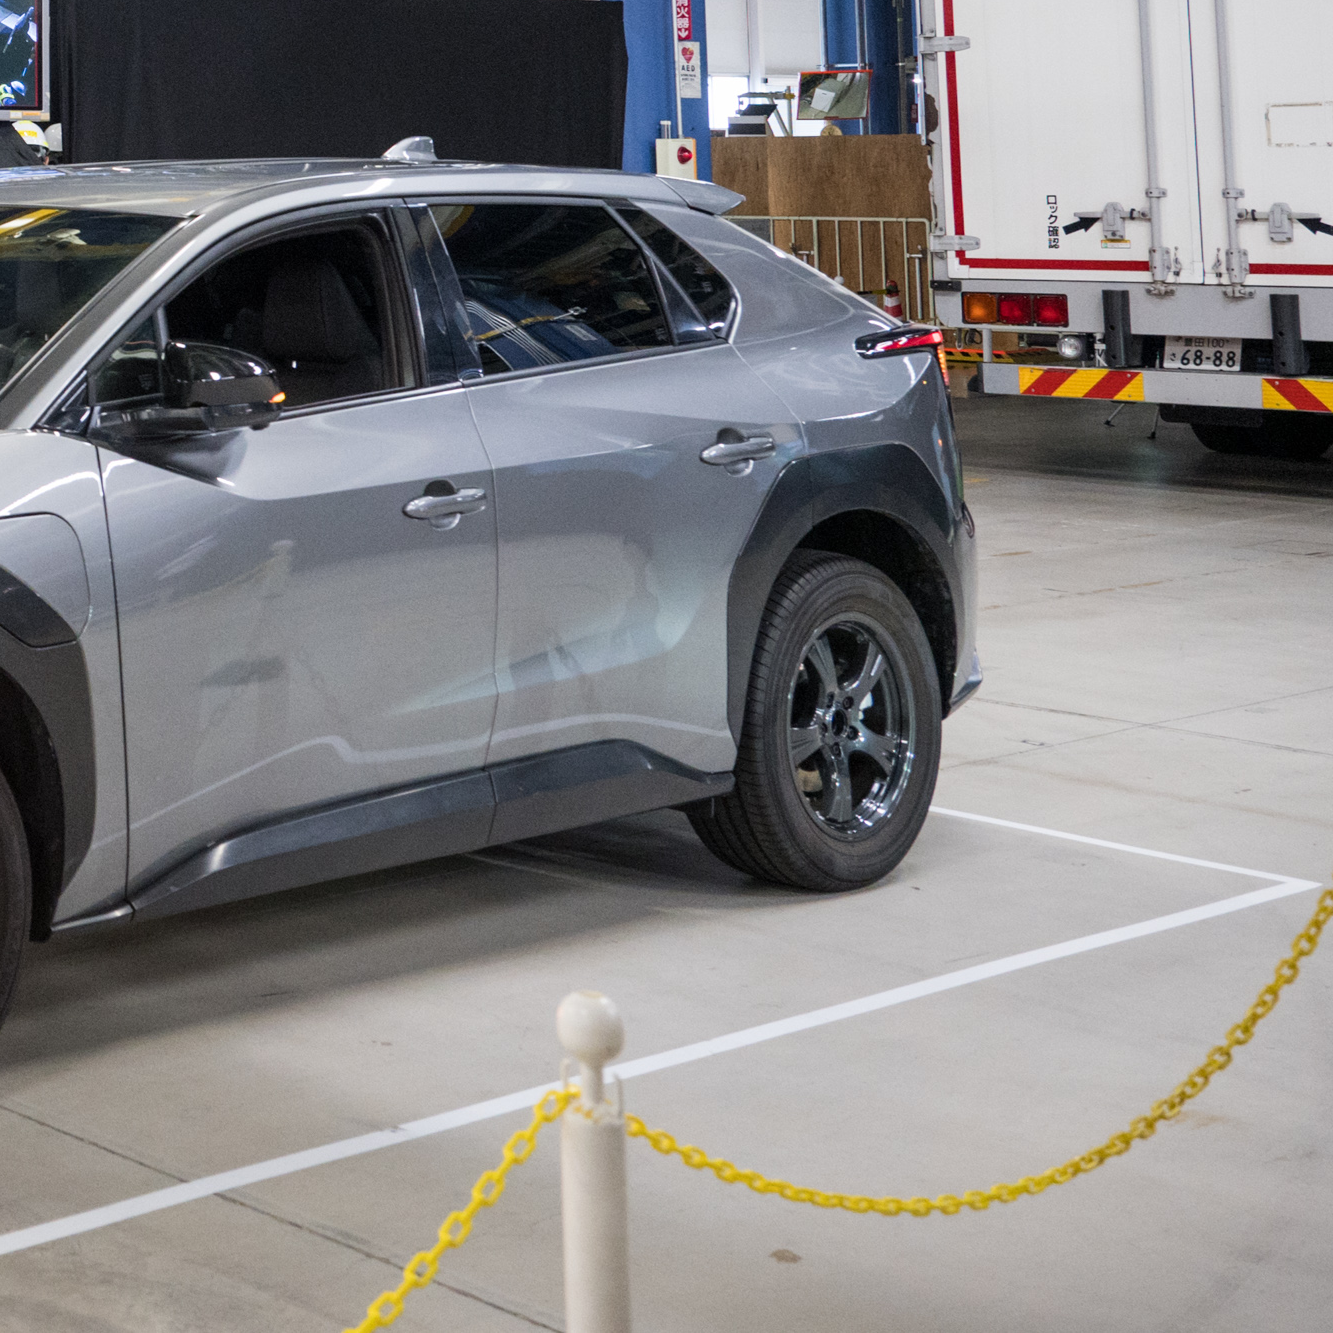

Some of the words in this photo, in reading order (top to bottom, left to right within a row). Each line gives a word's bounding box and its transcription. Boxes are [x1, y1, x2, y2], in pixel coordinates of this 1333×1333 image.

[681, 64, 696, 72] AED
[1046, 195, 1060, 249] ロック確認
[1180, 349, 1236, 368] 68-88
